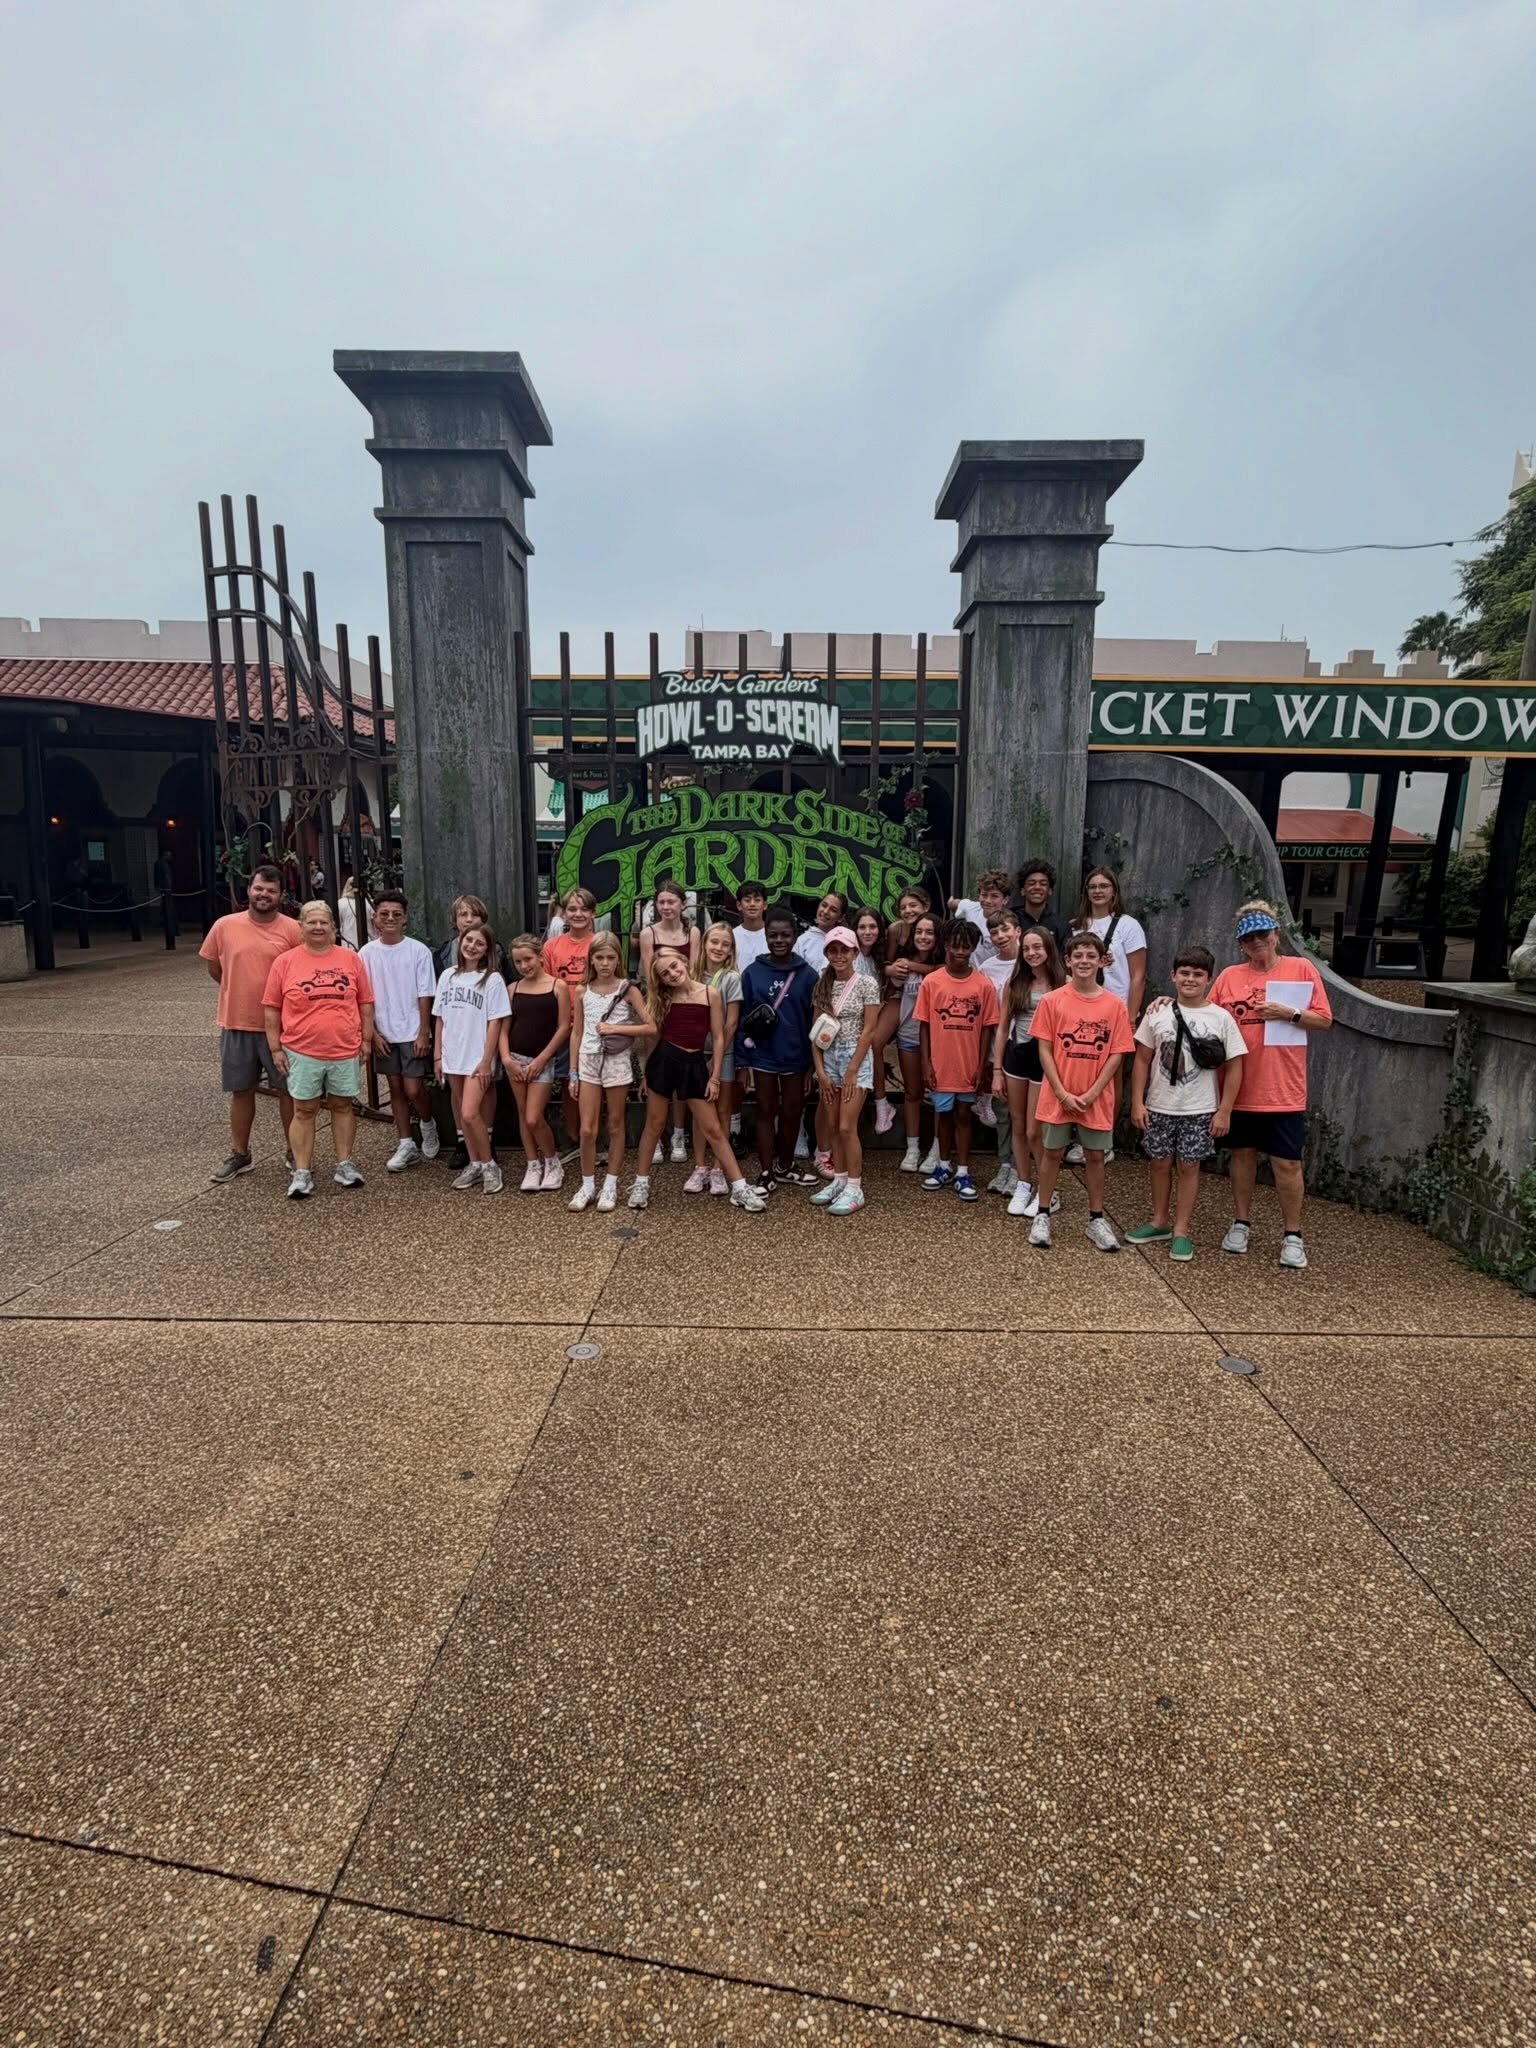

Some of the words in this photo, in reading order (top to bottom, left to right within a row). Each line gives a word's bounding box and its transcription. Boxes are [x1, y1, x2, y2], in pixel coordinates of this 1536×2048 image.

[661, 672, 735, 695] Busch
[736, 672, 820, 694] Gardens
[637, 699, 841, 764] HOWL-O-SCREAM
[1089, 691, 1251, 737] ICKET
[1273, 694, 1536, 743] WINDOW
[691, 745, 752, 759] TAMPA
[756, 744, 793, 759] BAY
[627, 801, 678, 835] THE
[671, 785, 793, 832] DARK
[793, 788, 881, 848] SIDE
[881, 820, 907, 843] OF
[556, 783, 924, 930] GARDENS
[880, 840, 921, 872] THE
[1292, 846, 1324, 857] TOUR
